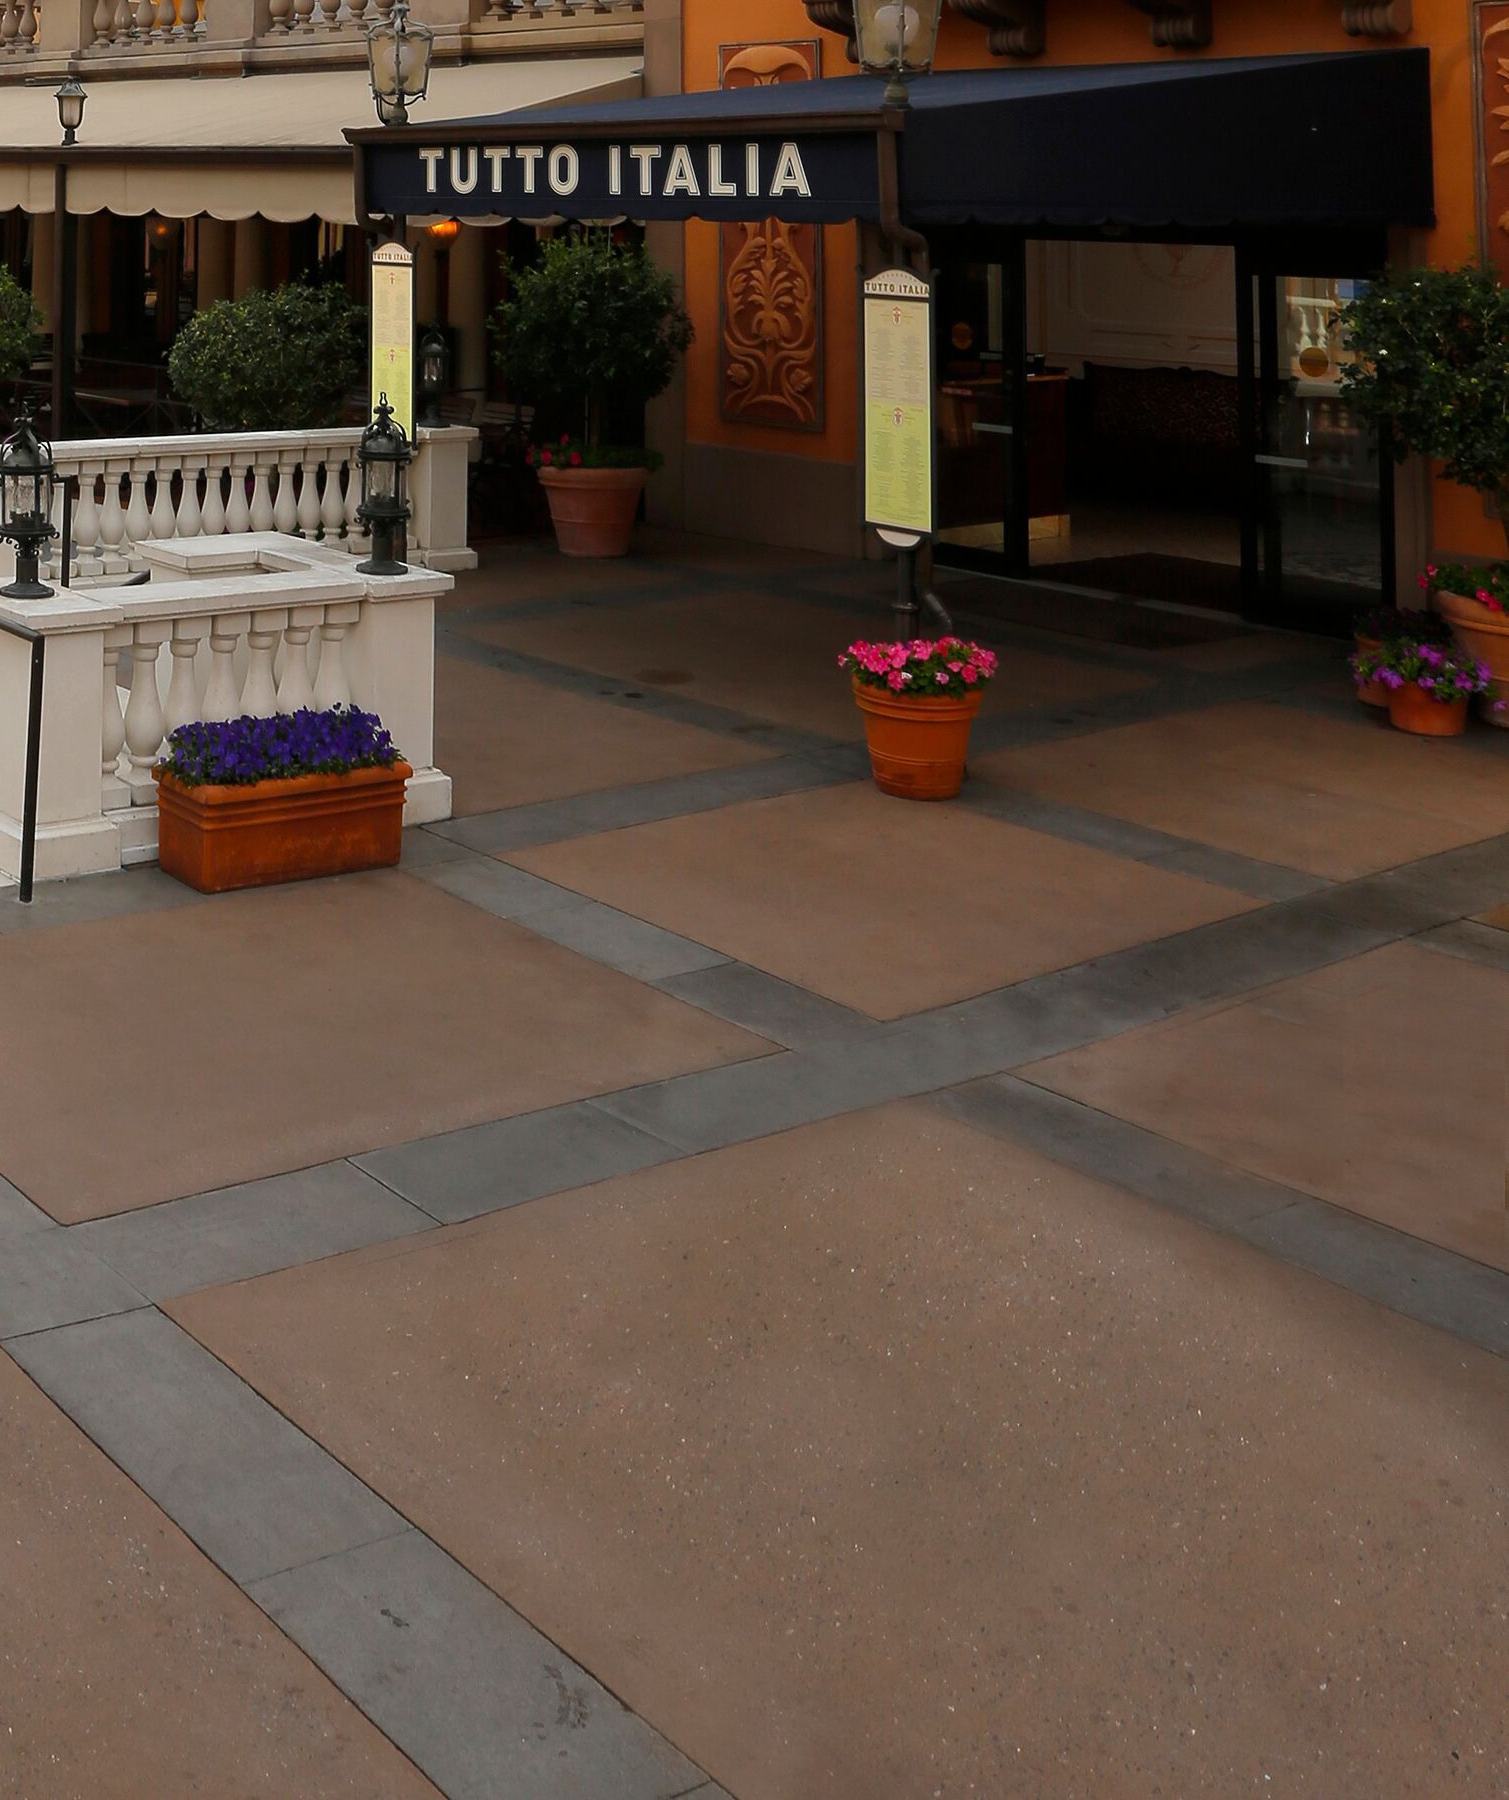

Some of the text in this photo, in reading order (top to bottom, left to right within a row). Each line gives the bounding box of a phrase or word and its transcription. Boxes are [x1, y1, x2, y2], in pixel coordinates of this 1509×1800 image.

[419, 142, 812, 197] TUTTO ITALIA
[865, 282, 895, 293] TUTTO
